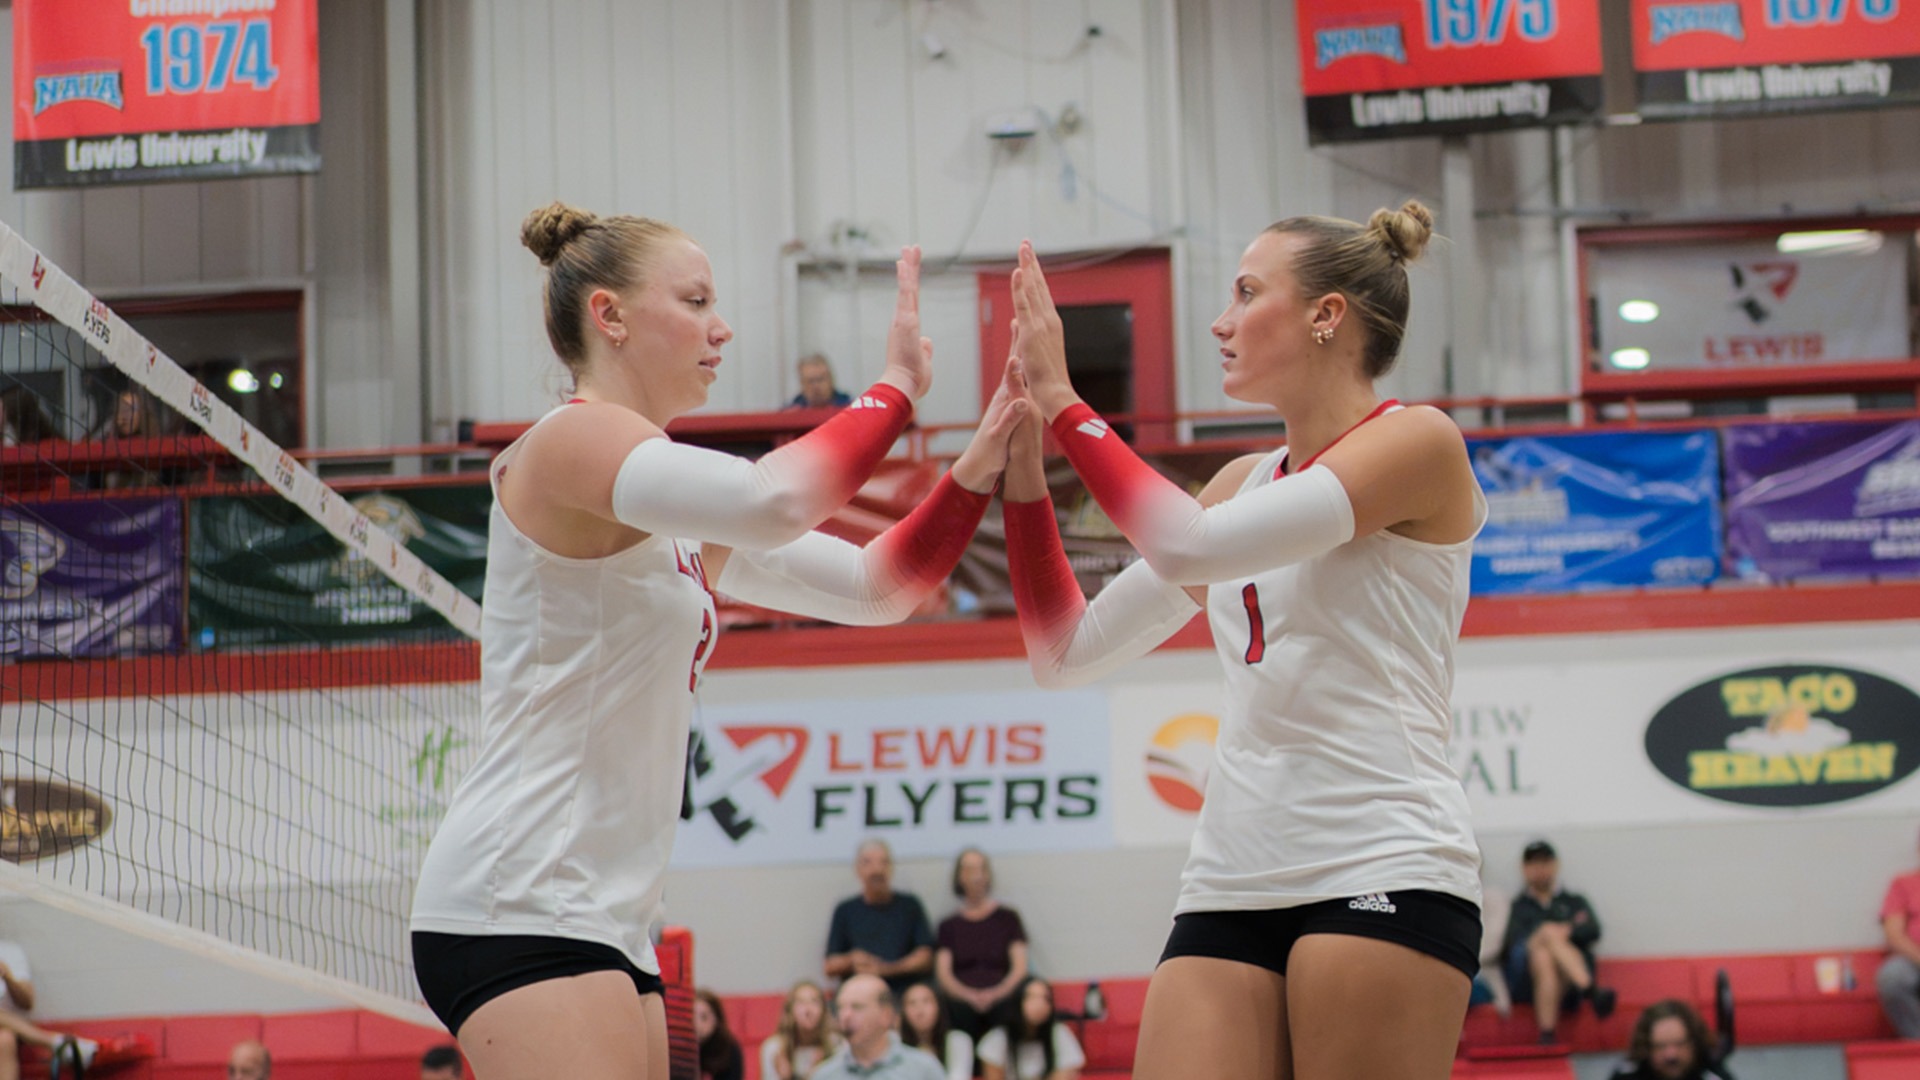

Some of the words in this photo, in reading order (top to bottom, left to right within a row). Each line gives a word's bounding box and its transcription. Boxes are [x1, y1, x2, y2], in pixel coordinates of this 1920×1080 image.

[141, 18, 279, 95] 1974
[33, 70, 125, 117] NAIA
[65, 137, 137, 173] Lewis
[140, 127, 268, 166] University
[1703, 331, 1825, 363] LEWIS
[1242, 582, 1265, 664] 1
[1722, 674, 1856, 716] TACO
[827, 723, 1046, 774] LEWIS
[1450, 747, 1539, 797] AL
[1687, 743, 1898, 790] HEAVEN
[812, 774, 1101, 830] FLYERS
[1349, 899, 1398, 914] adidas
